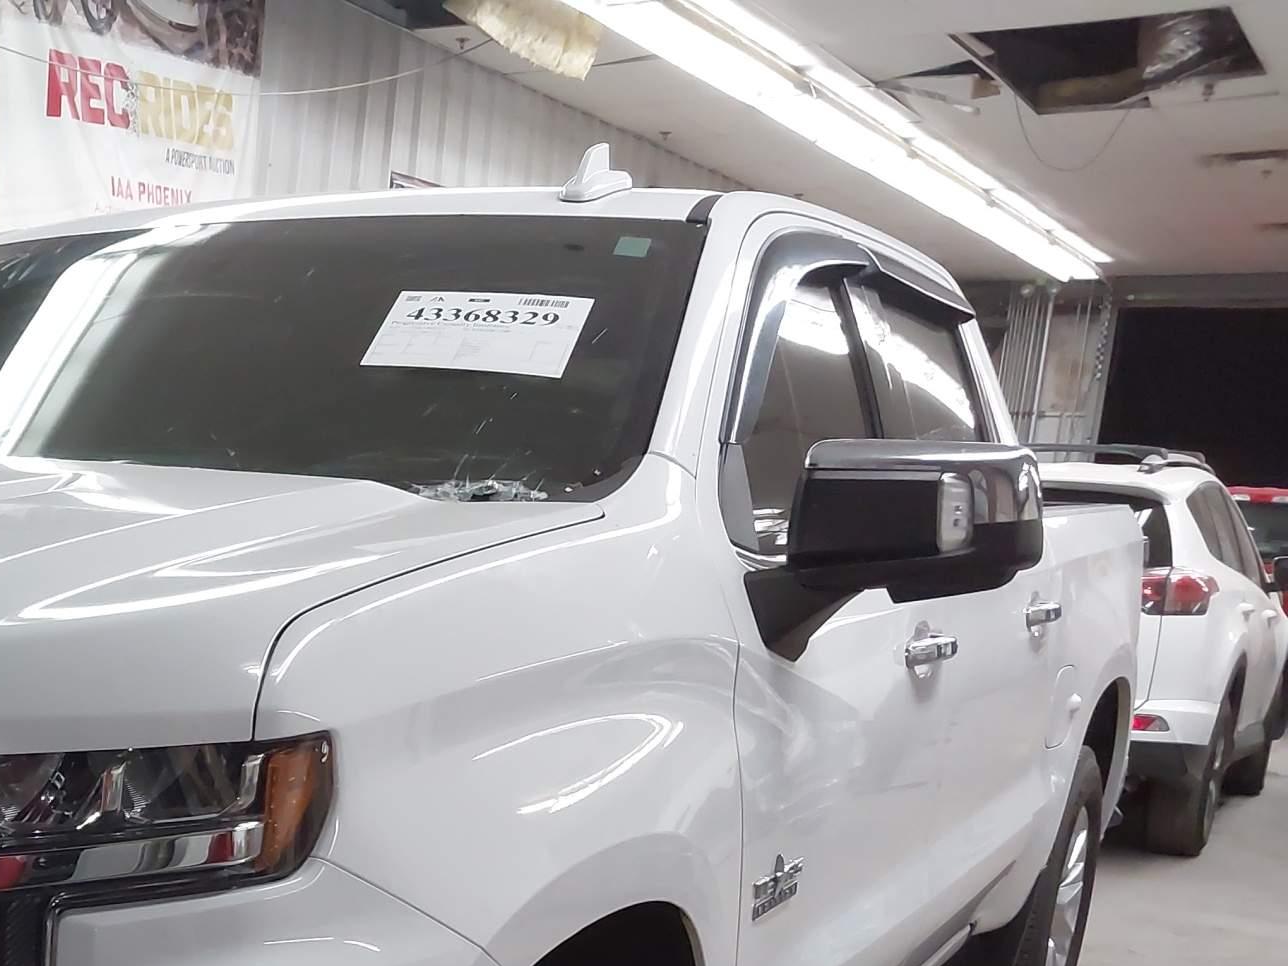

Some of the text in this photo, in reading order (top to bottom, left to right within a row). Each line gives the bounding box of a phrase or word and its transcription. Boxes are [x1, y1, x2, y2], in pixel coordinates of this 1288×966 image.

[46, 49, 234, 151] REC RIDES
[111, 176, 133, 200] IAA
[138, 181, 192, 207] PHOENIX
[406, 307, 560, 326] 43368329
